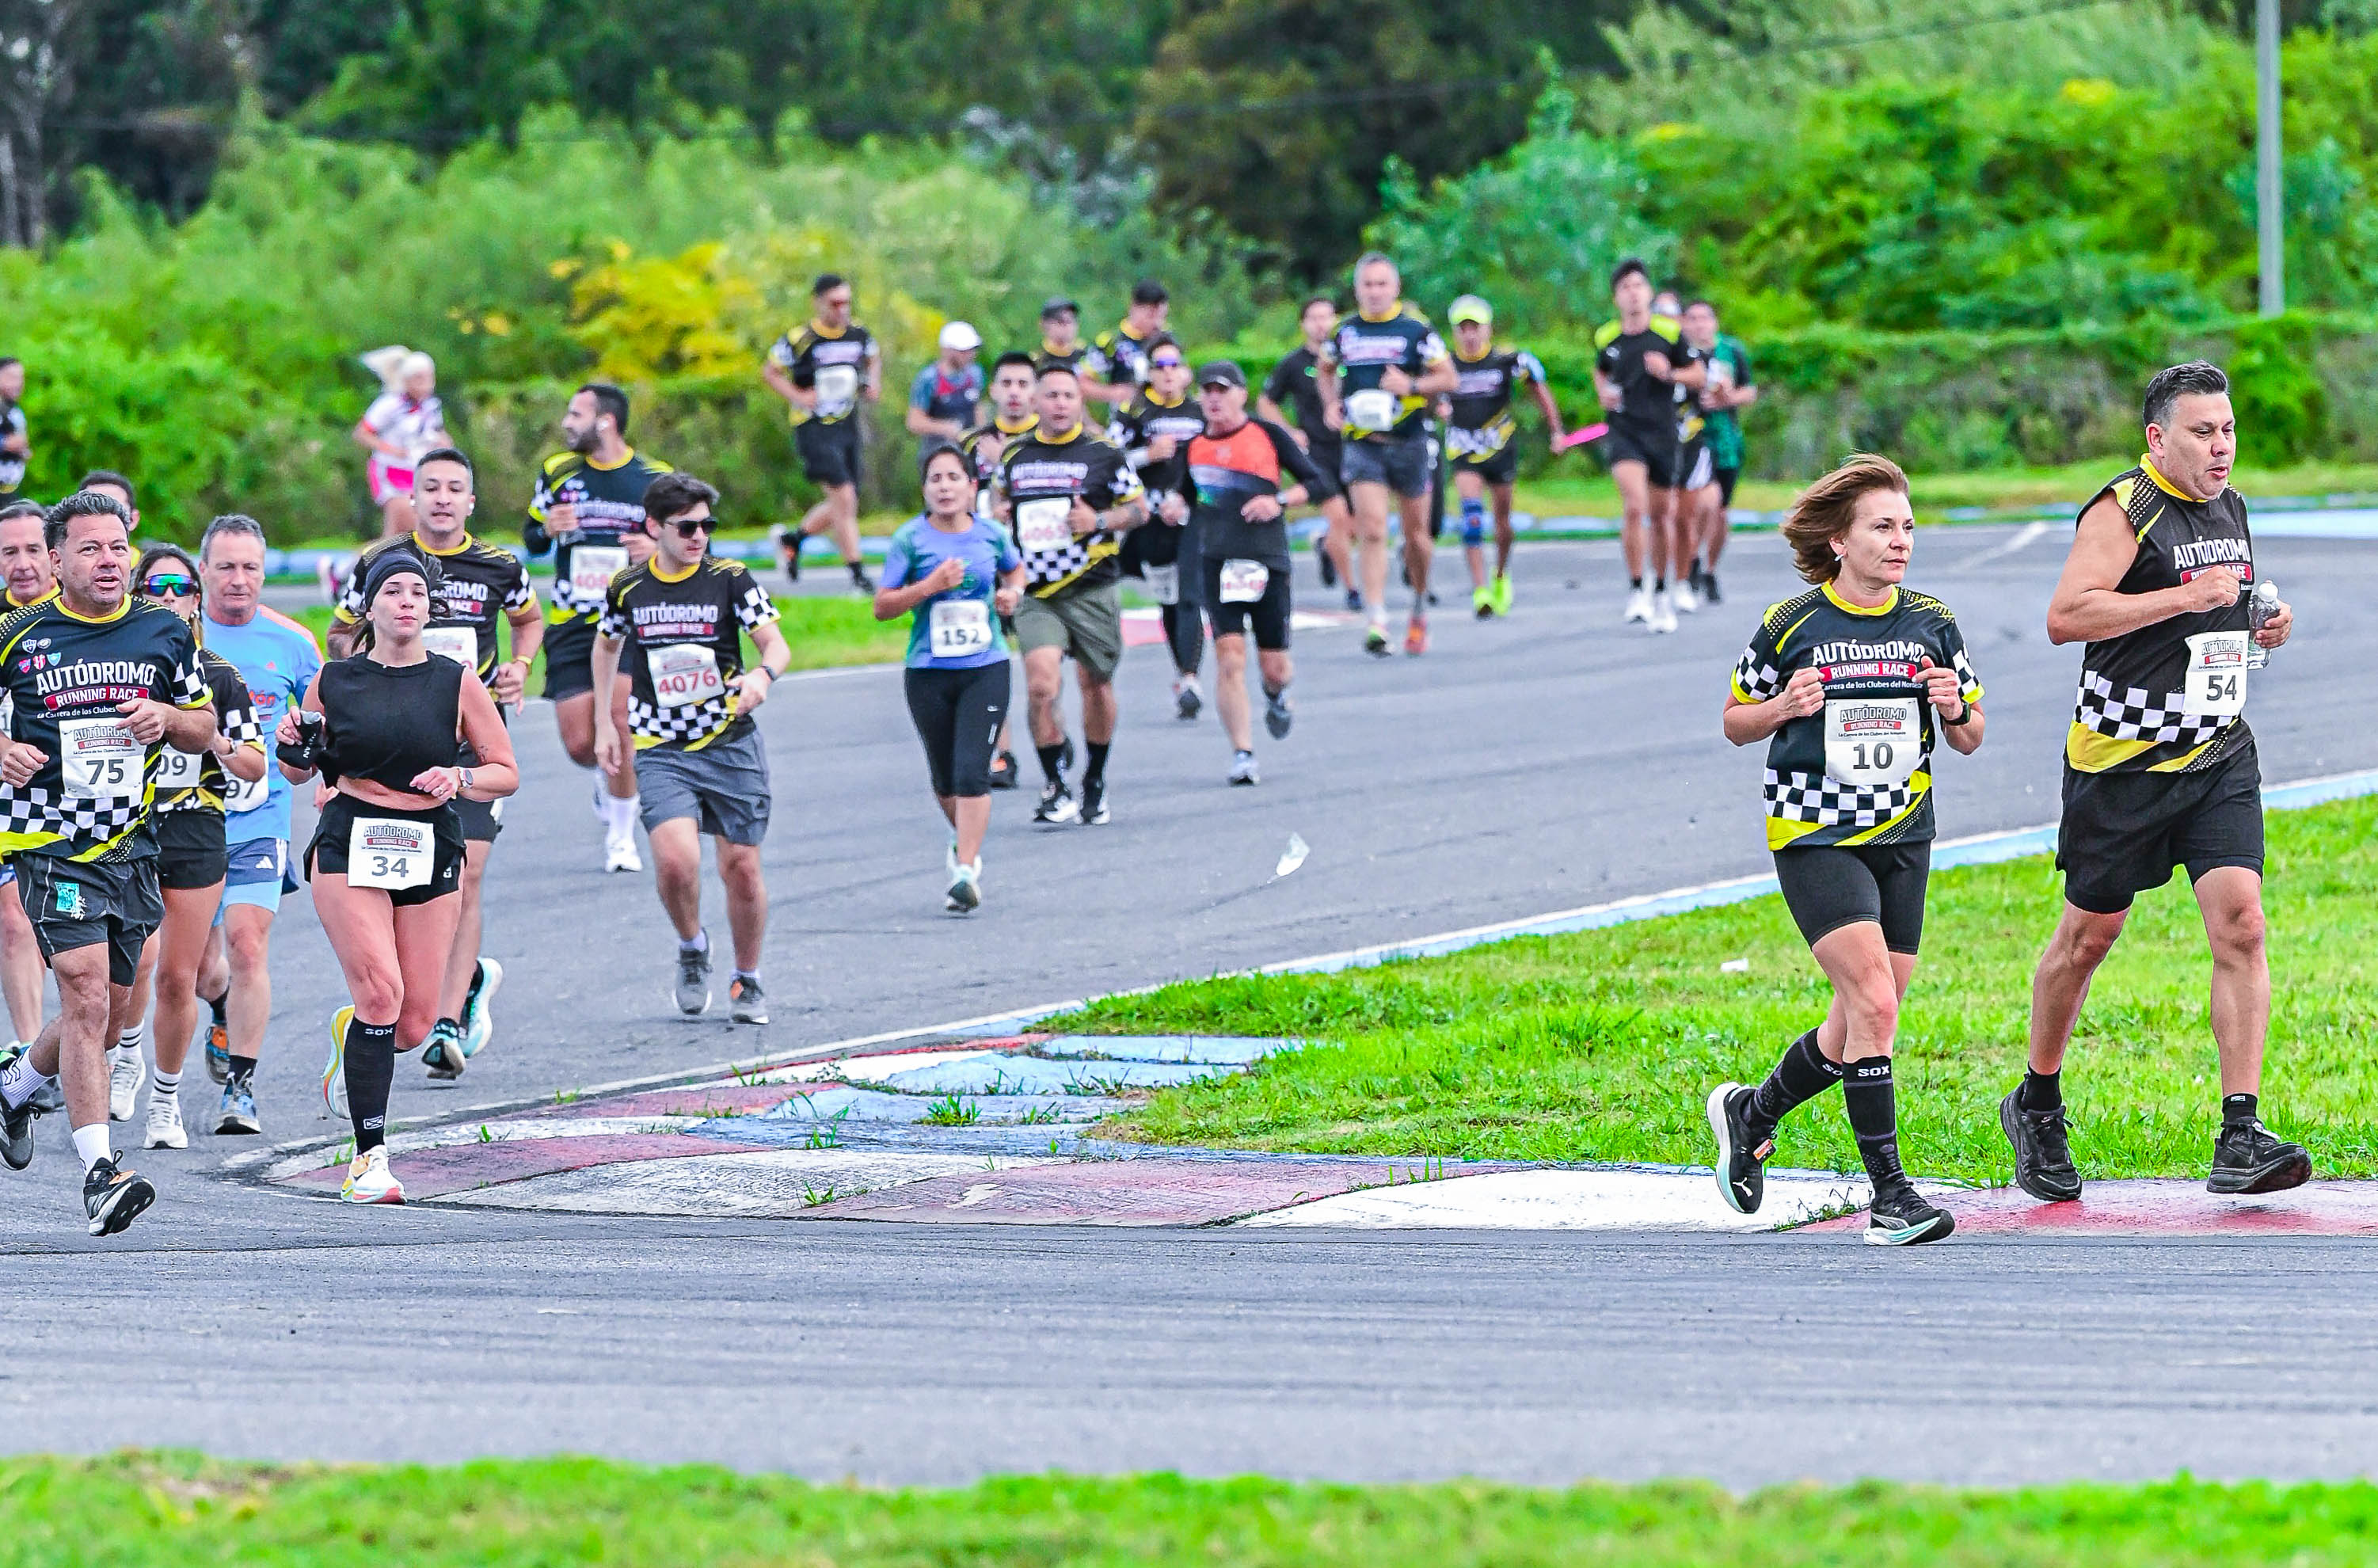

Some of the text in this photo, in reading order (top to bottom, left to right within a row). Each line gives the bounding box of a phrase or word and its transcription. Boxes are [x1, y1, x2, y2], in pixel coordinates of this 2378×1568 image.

[2173, 535, 2251, 569] AUTÓDROMO
[943, 628, 981, 646] 152
[1813, 638, 1925, 666] AUTÓDROMO
[36, 657, 157, 695] AUTÓDROMO
[659, 668, 717, 694] 4076
[1830, 663, 1909, 679] RUNNING RACE
[55, 687, 139, 707] RUNNING RACE
[2206, 676, 2237, 701] 54
[1840, 704, 1907, 722] AUTÓDROMO
[1853, 743, 1893, 769] 10
[86, 759, 124, 785] 75
[363, 823, 423, 840] AUTÓDROMO
[371, 855, 409, 877] 34
[364, 1027, 394, 1036] SOX
[1821, 1064, 1843, 1075] SO
[1857, 1065, 1890, 1077] SOX
